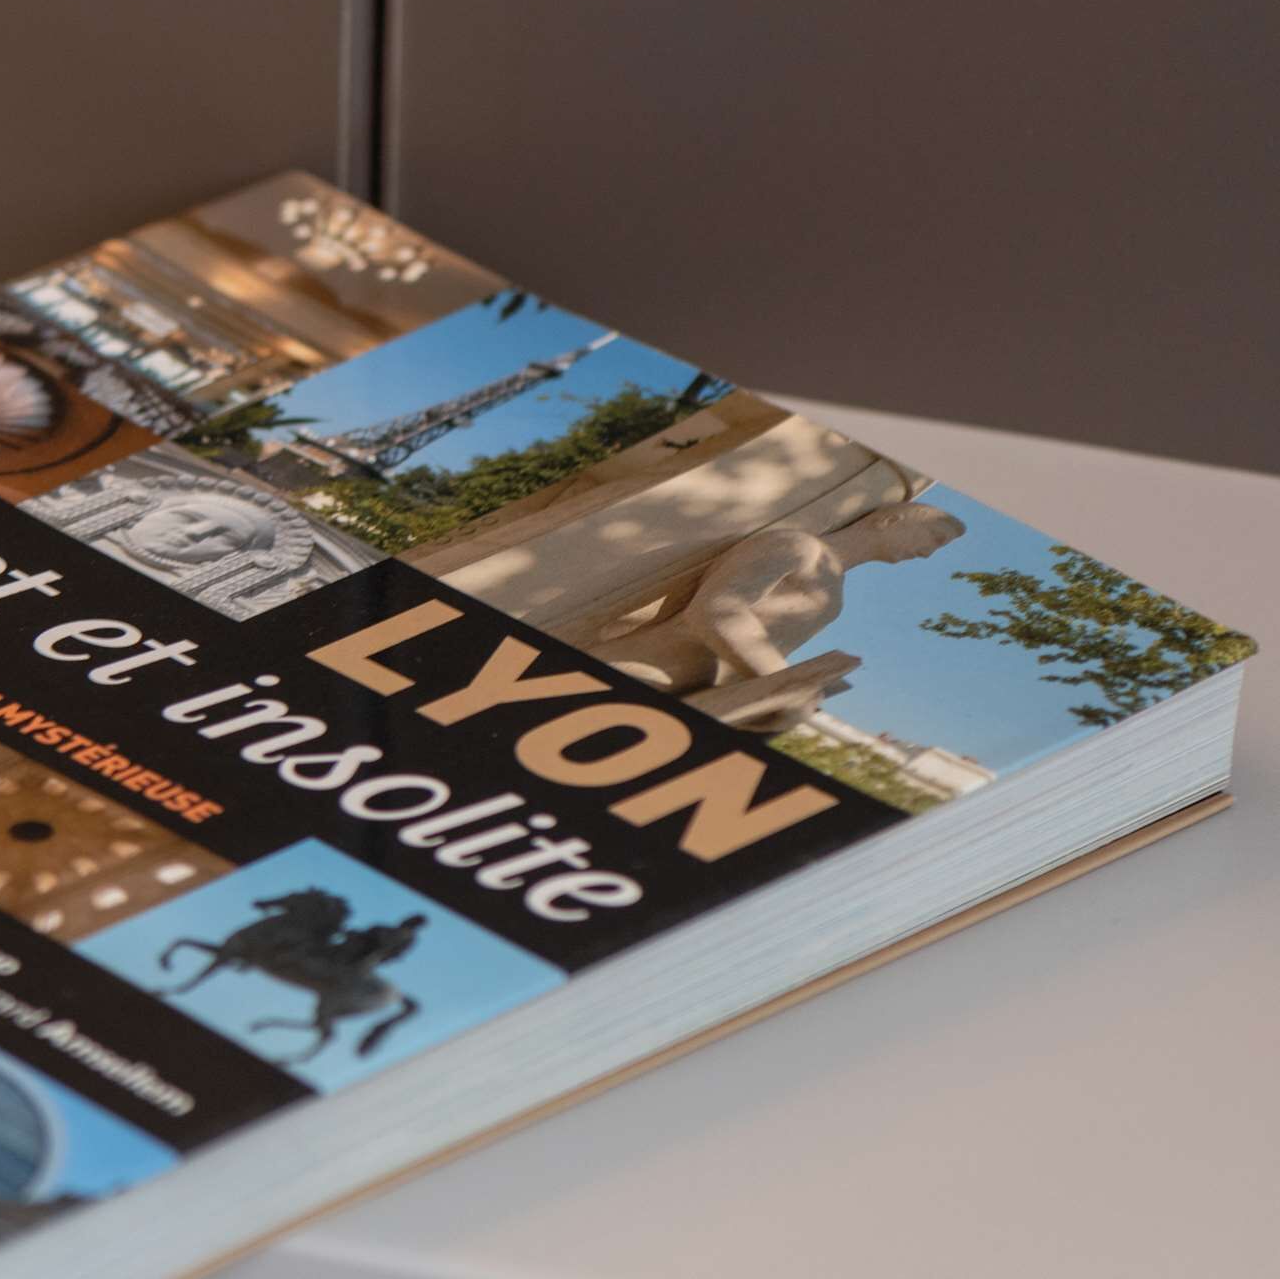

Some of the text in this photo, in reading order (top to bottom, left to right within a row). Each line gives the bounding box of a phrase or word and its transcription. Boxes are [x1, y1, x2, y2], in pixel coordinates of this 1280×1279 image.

[32, 617, 199, 686] et
[160, 674, 644, 921] insolite
[304, 598, 842, 864] LYON
